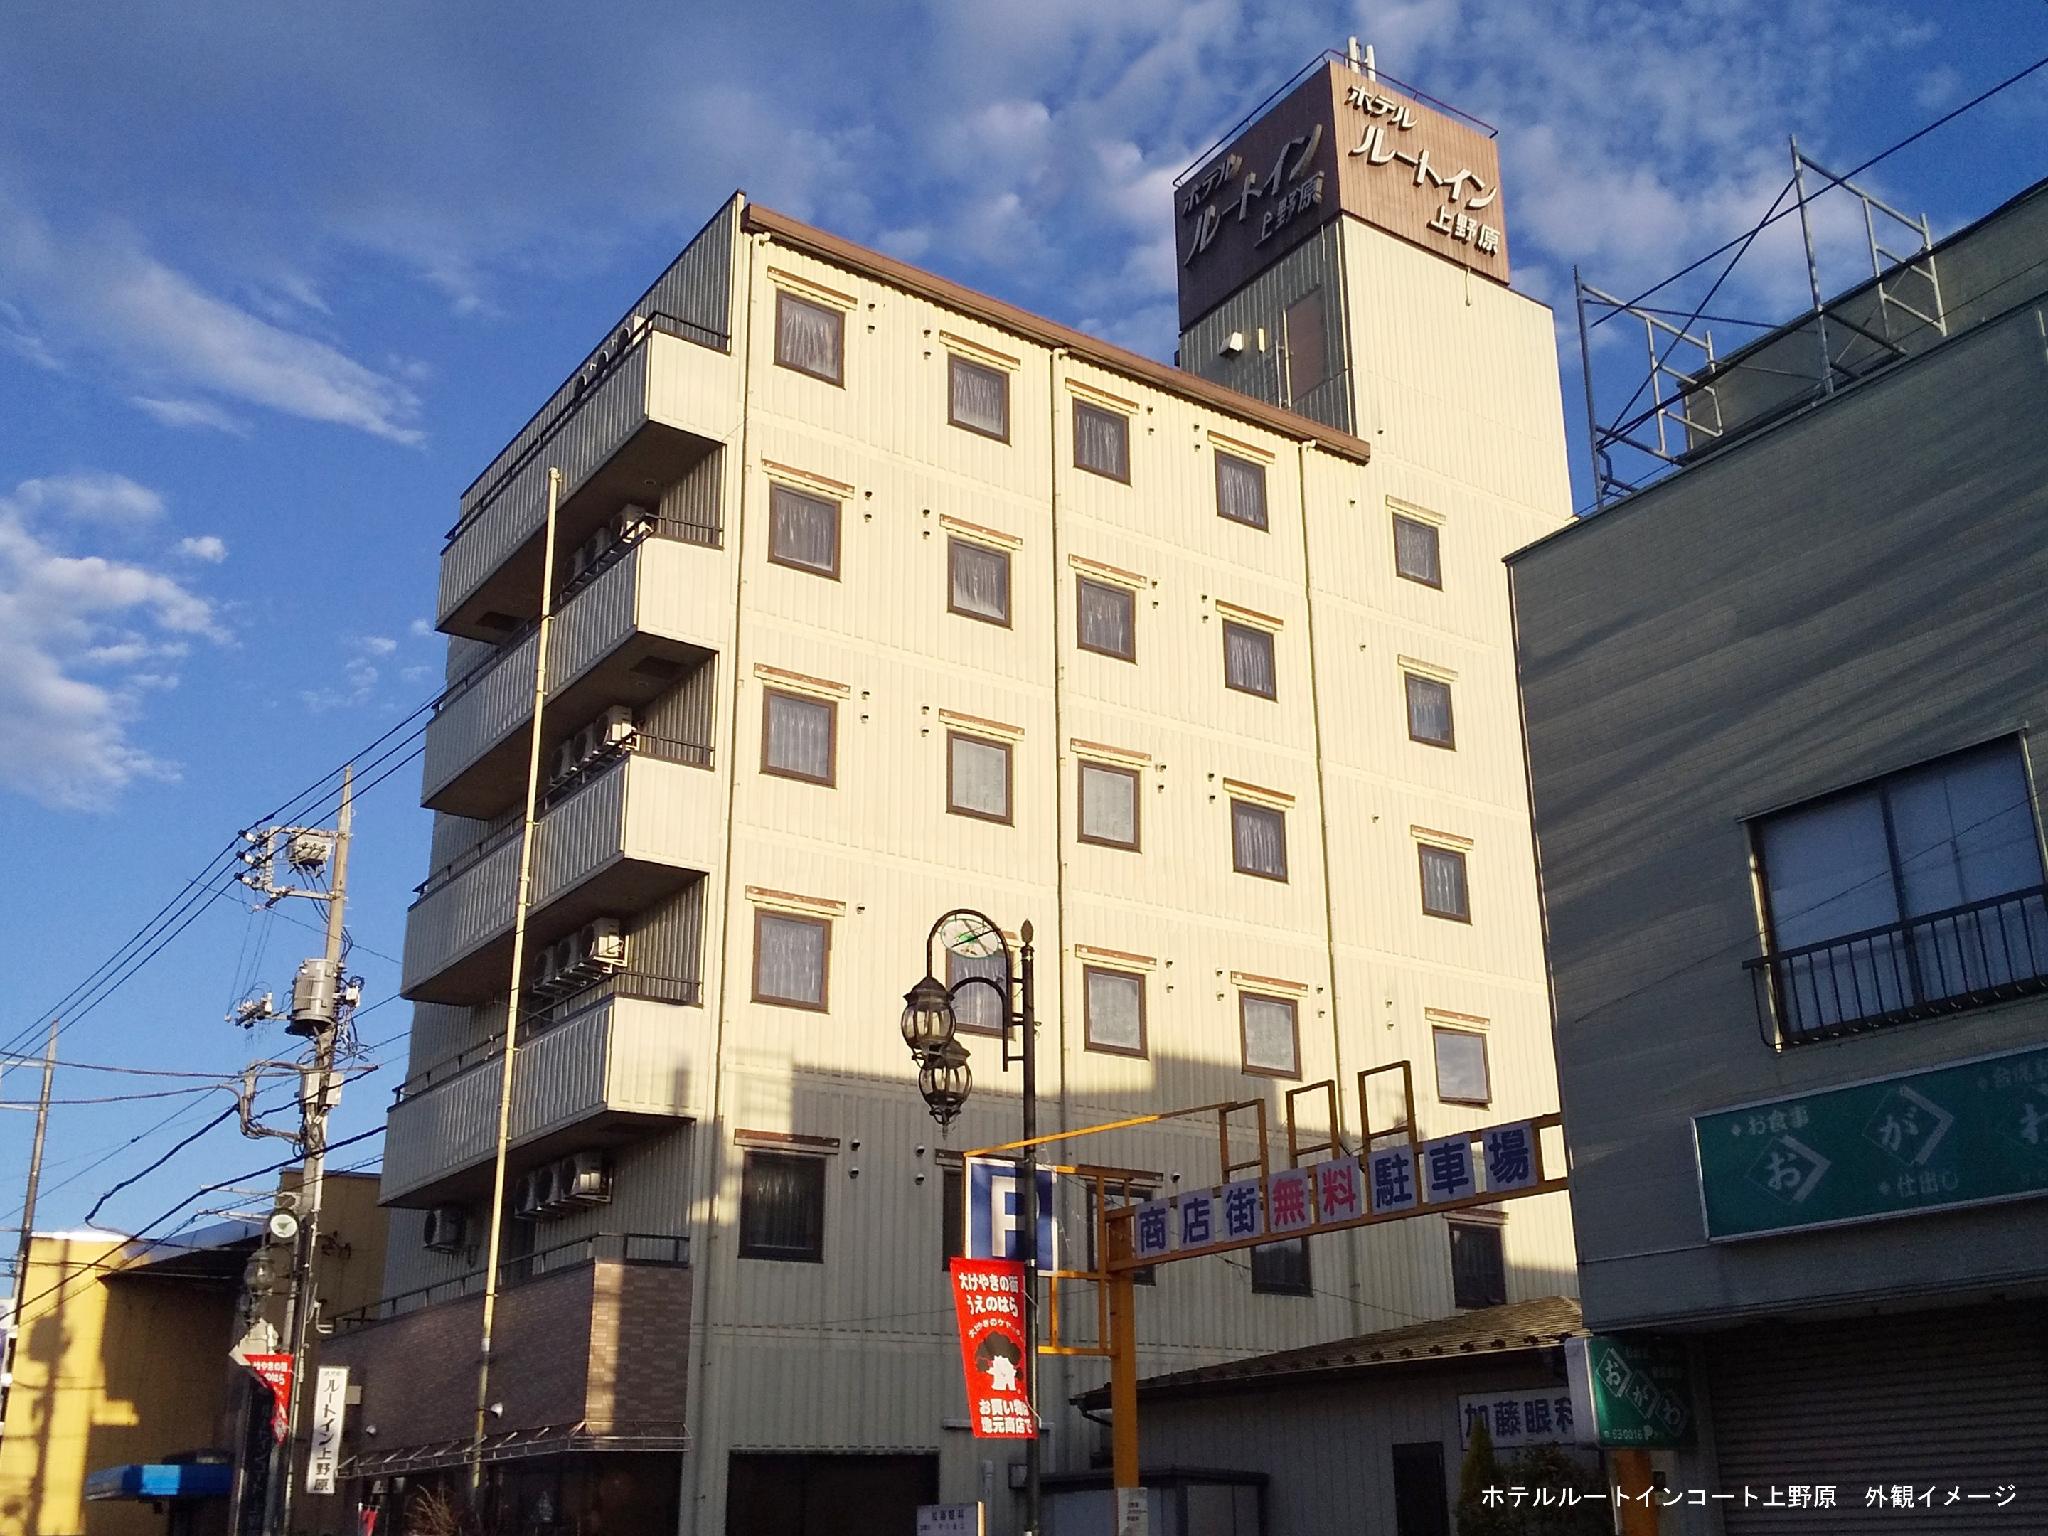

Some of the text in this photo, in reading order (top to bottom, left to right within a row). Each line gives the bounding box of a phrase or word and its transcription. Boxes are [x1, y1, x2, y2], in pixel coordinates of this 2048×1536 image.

[1347, 85, 1418, 129] ホテル
[1182, 153, 1243, 216] ホテル
[1184, 124, 1323, 267] ルートイン
[1349, 124, 1498, 210] ルートイン
[1427, 203, 1501, 255] 上野原
[1748, 1105, 1809, 1136] お食事
[1139, 1122, 1532, 1251] 商店街無料駐車場
[966, 1295, 1018, 1317] うえのはら
[313, 1379, 339, 1491] ルートイン上野原
